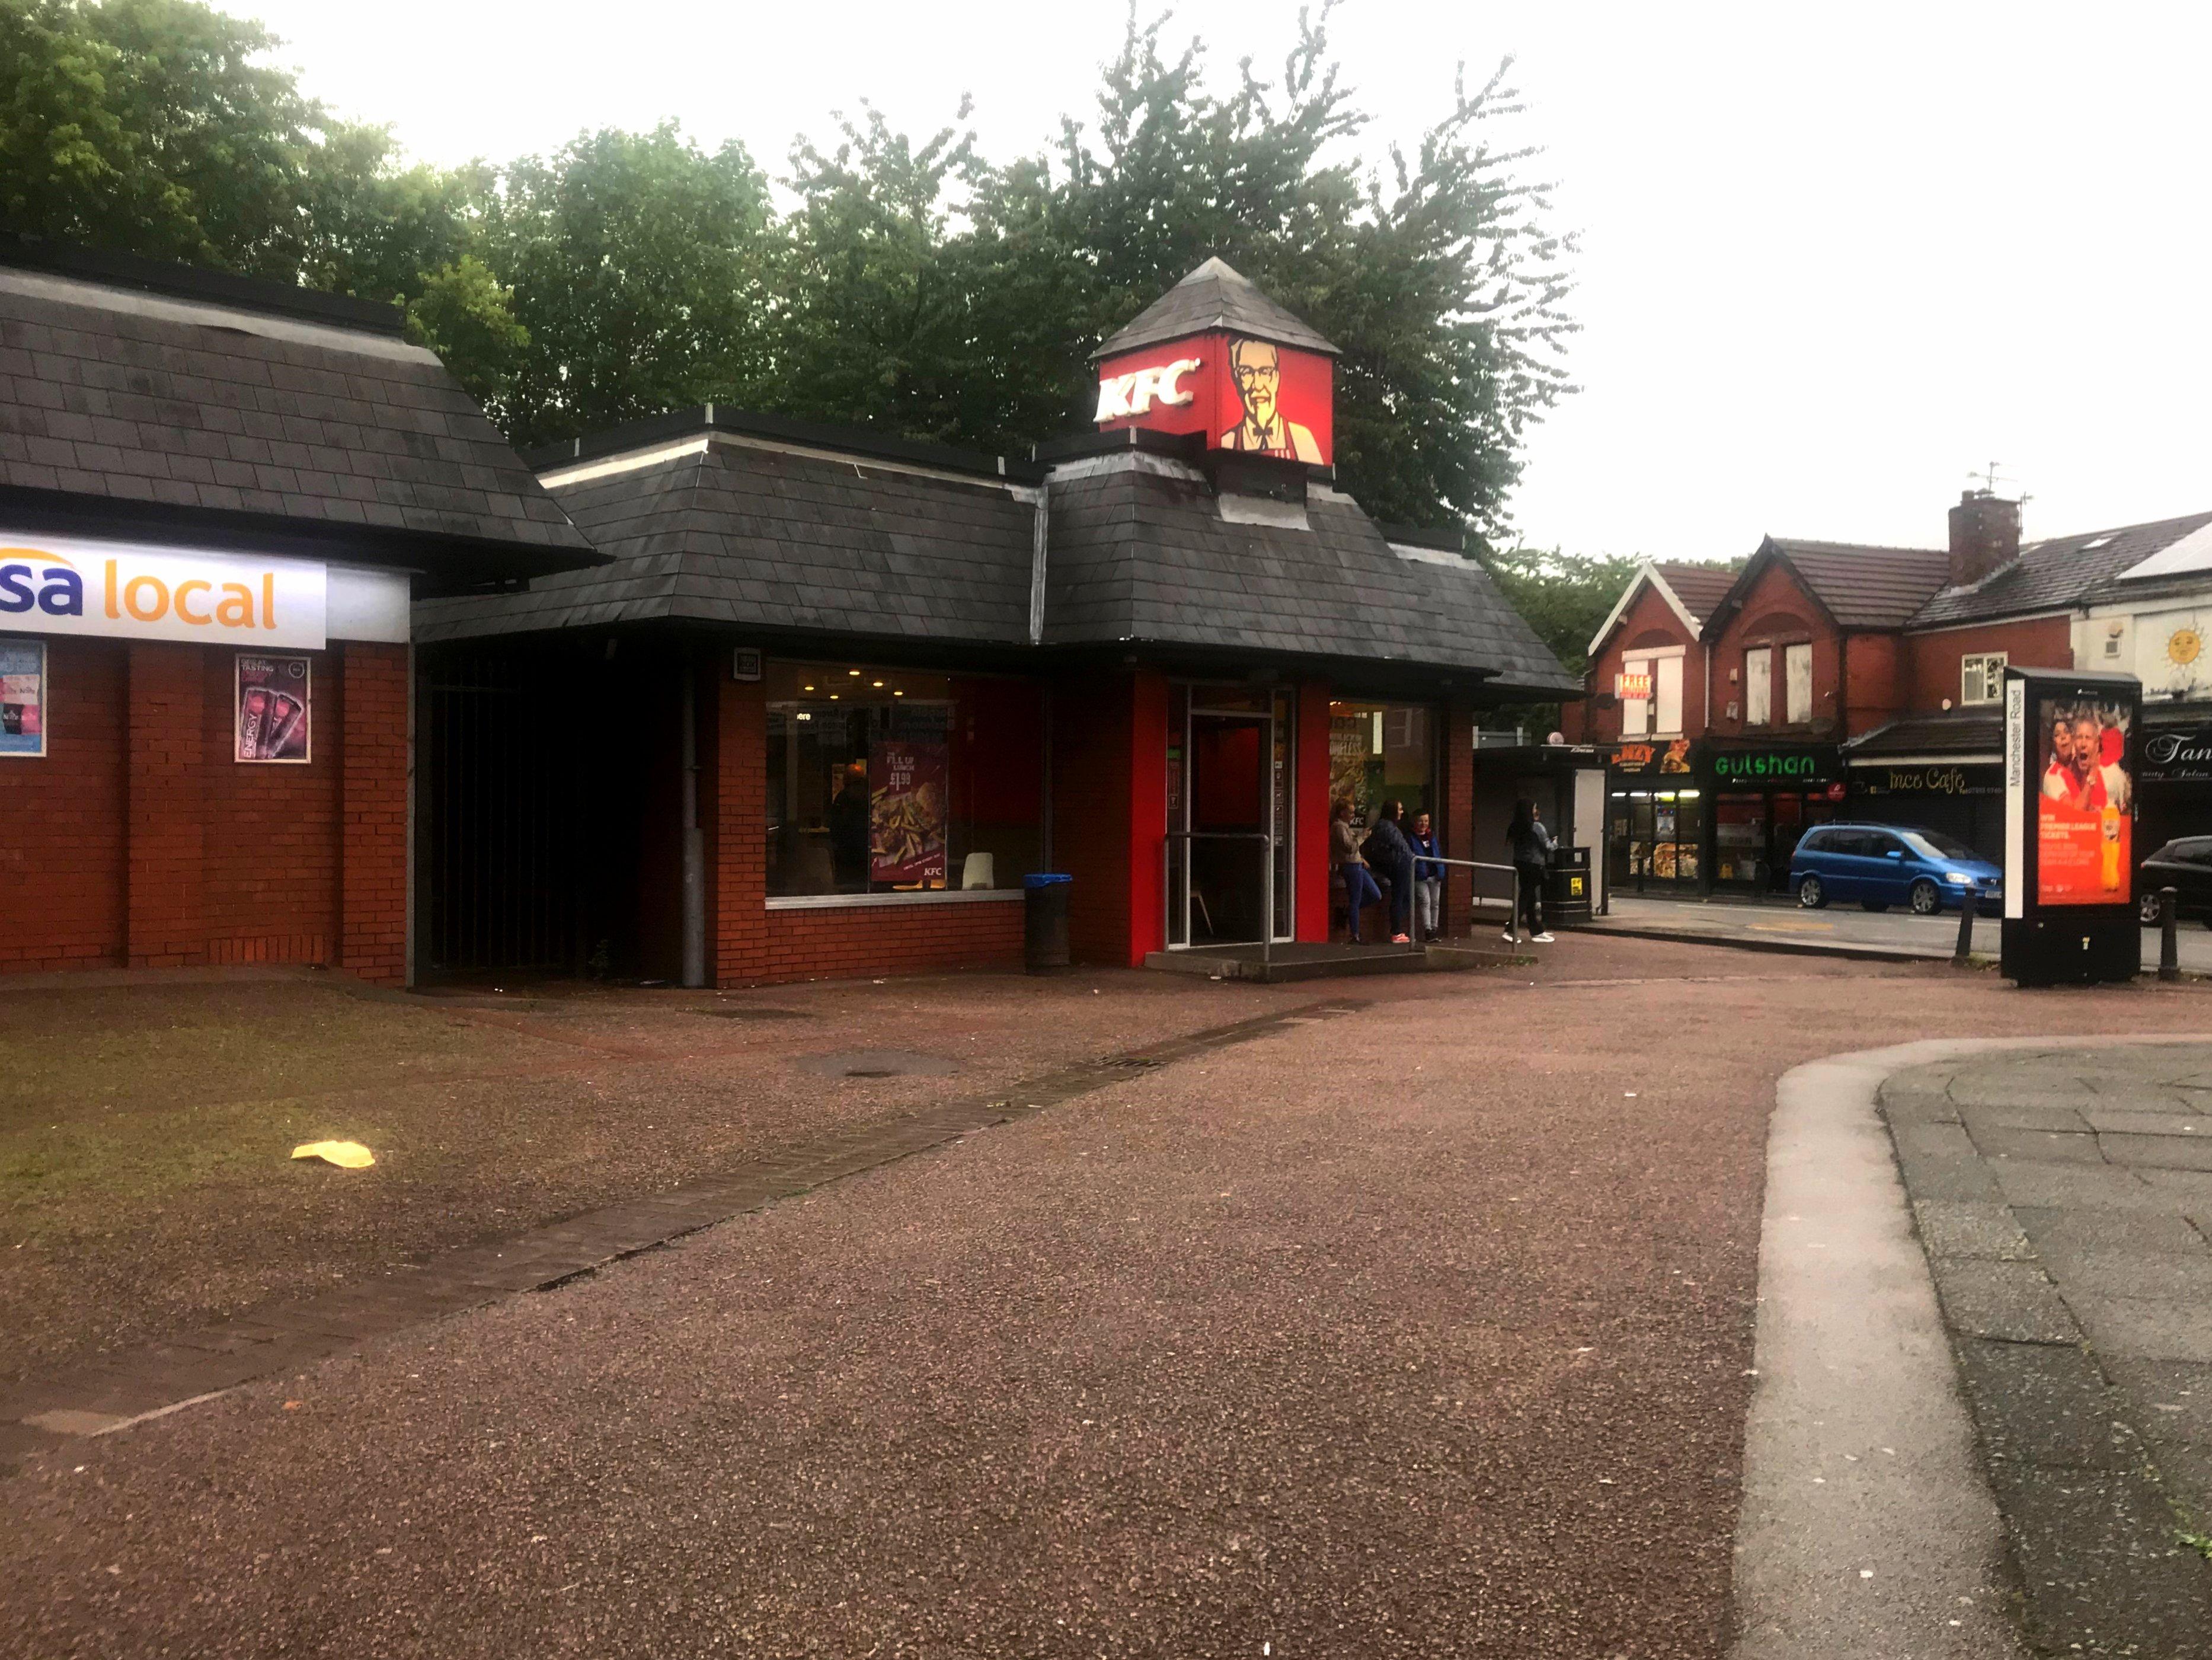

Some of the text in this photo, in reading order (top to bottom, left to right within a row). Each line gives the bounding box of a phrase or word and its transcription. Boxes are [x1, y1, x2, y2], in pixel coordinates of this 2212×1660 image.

[1093, 357, 1196, 422] KFC
[104, 559, 277, 630] local
[244, 713, 257, 758] ENERGY
[2010, 690, 2021, 787] Manchester Road
[889, 772, 911, 791] £1.99
[1926, 767, 1965, 794] Cafe
[924, 867, 942, 876] KFC
